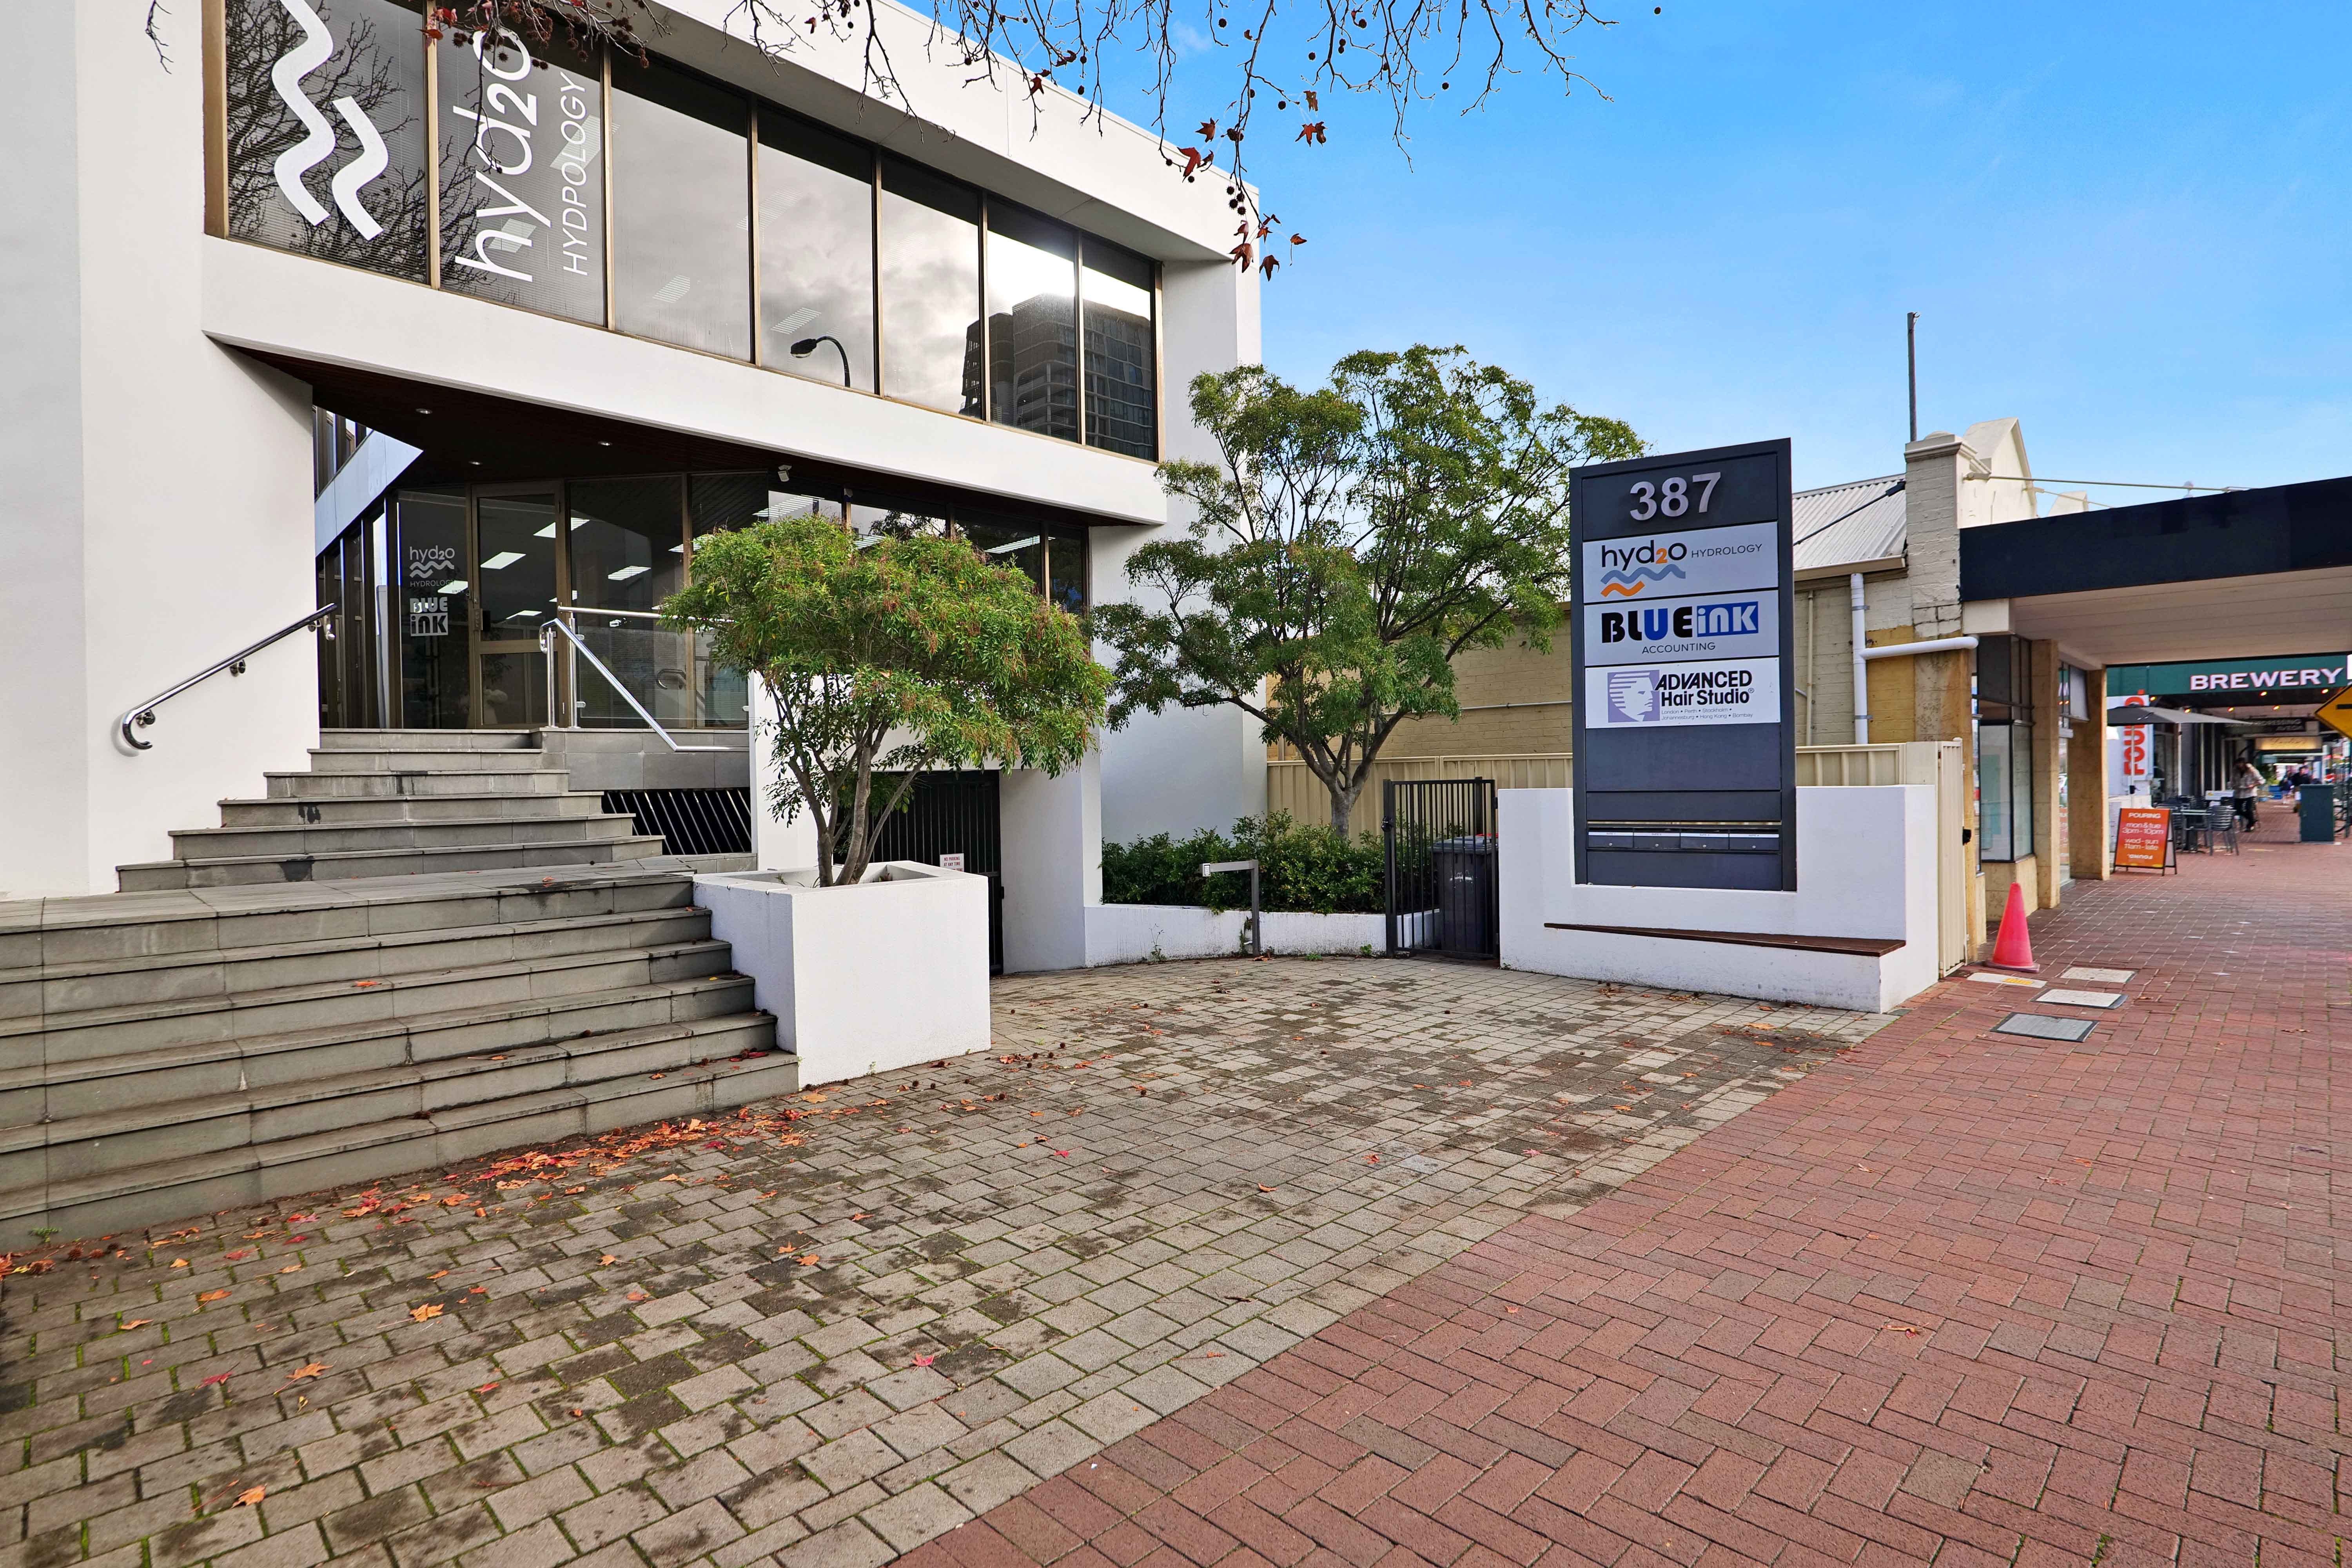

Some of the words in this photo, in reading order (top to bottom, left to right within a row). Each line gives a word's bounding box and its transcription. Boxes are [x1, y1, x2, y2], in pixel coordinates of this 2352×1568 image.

[1629, 472, 1721, 521] 387
[410, 545, 455, 563] hyd2o
[1602, 540, 1687, 571] hyd2o
[1691, 544, 1762, 558] HYDROLOGY
[410, 597, 448, 613] BLUE
[1601, 606, 1693, 643] BLUE
[1642, 642, 1715, 654] ACCOUNTING
[1655, 670, 1752, 690] ADVANCED
[2190, 667, 2344, 690] BREWERY
[1661, 691, 1694, 706] Hair
[1697, 688, 1749, 705] Studio
